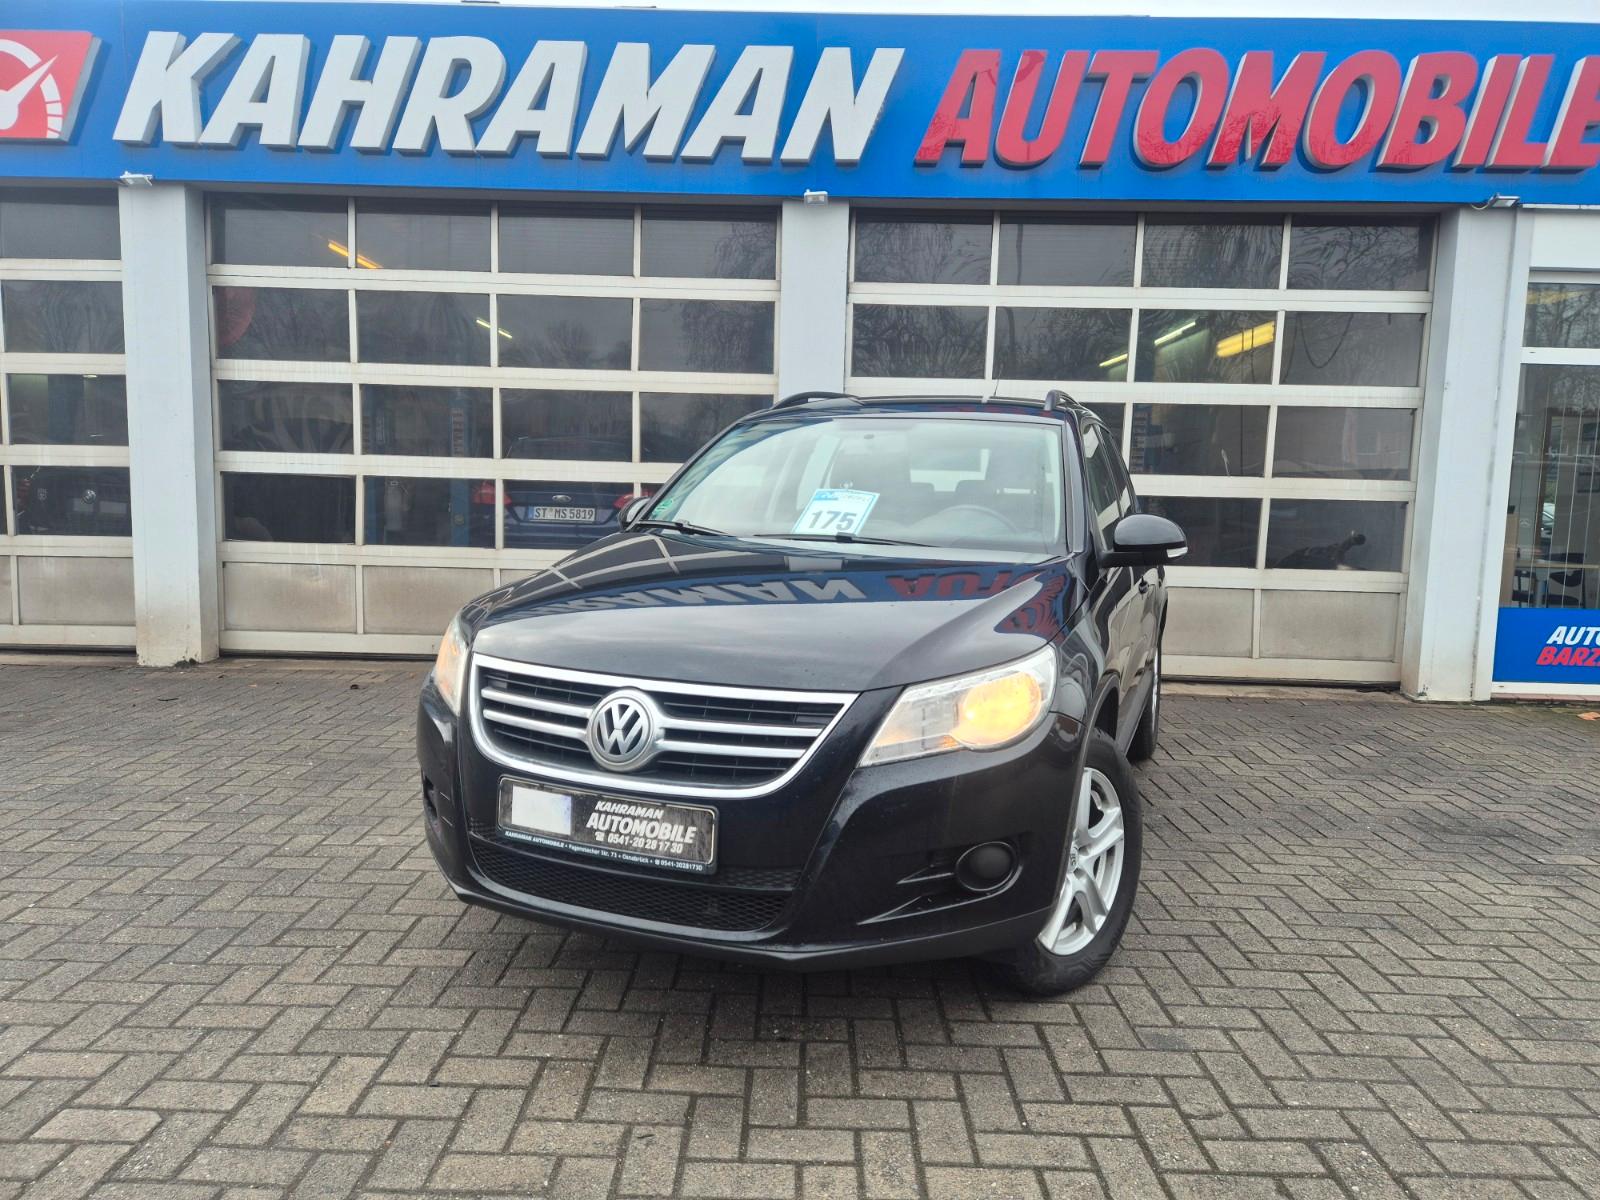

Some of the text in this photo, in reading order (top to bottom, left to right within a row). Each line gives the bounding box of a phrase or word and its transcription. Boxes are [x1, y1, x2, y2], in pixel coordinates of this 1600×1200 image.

[112, 31, 1600, 171] KAHRAMAN AUTOMOBILE
[535, 507, 594, 520] ST MS 5819
[808, 510, 857, 531] 175
[1546, 626, 1600, 646] AUT
[1536, 646, 1600, 667] BARZ
[594, 699, 648, 760] VW
[595, 801, 664, 819] KAHRAMAN
[586, 812, 697, 843] AUTOMOBILE
[505, 830, 532, 841] KAHRAMAN
[532, 836, 565, 848] AUTOMOBILE
[645, 838, 657, 850] 28
[659, 841, 671, 852] 17
[670, 842, 683, 854] 30
